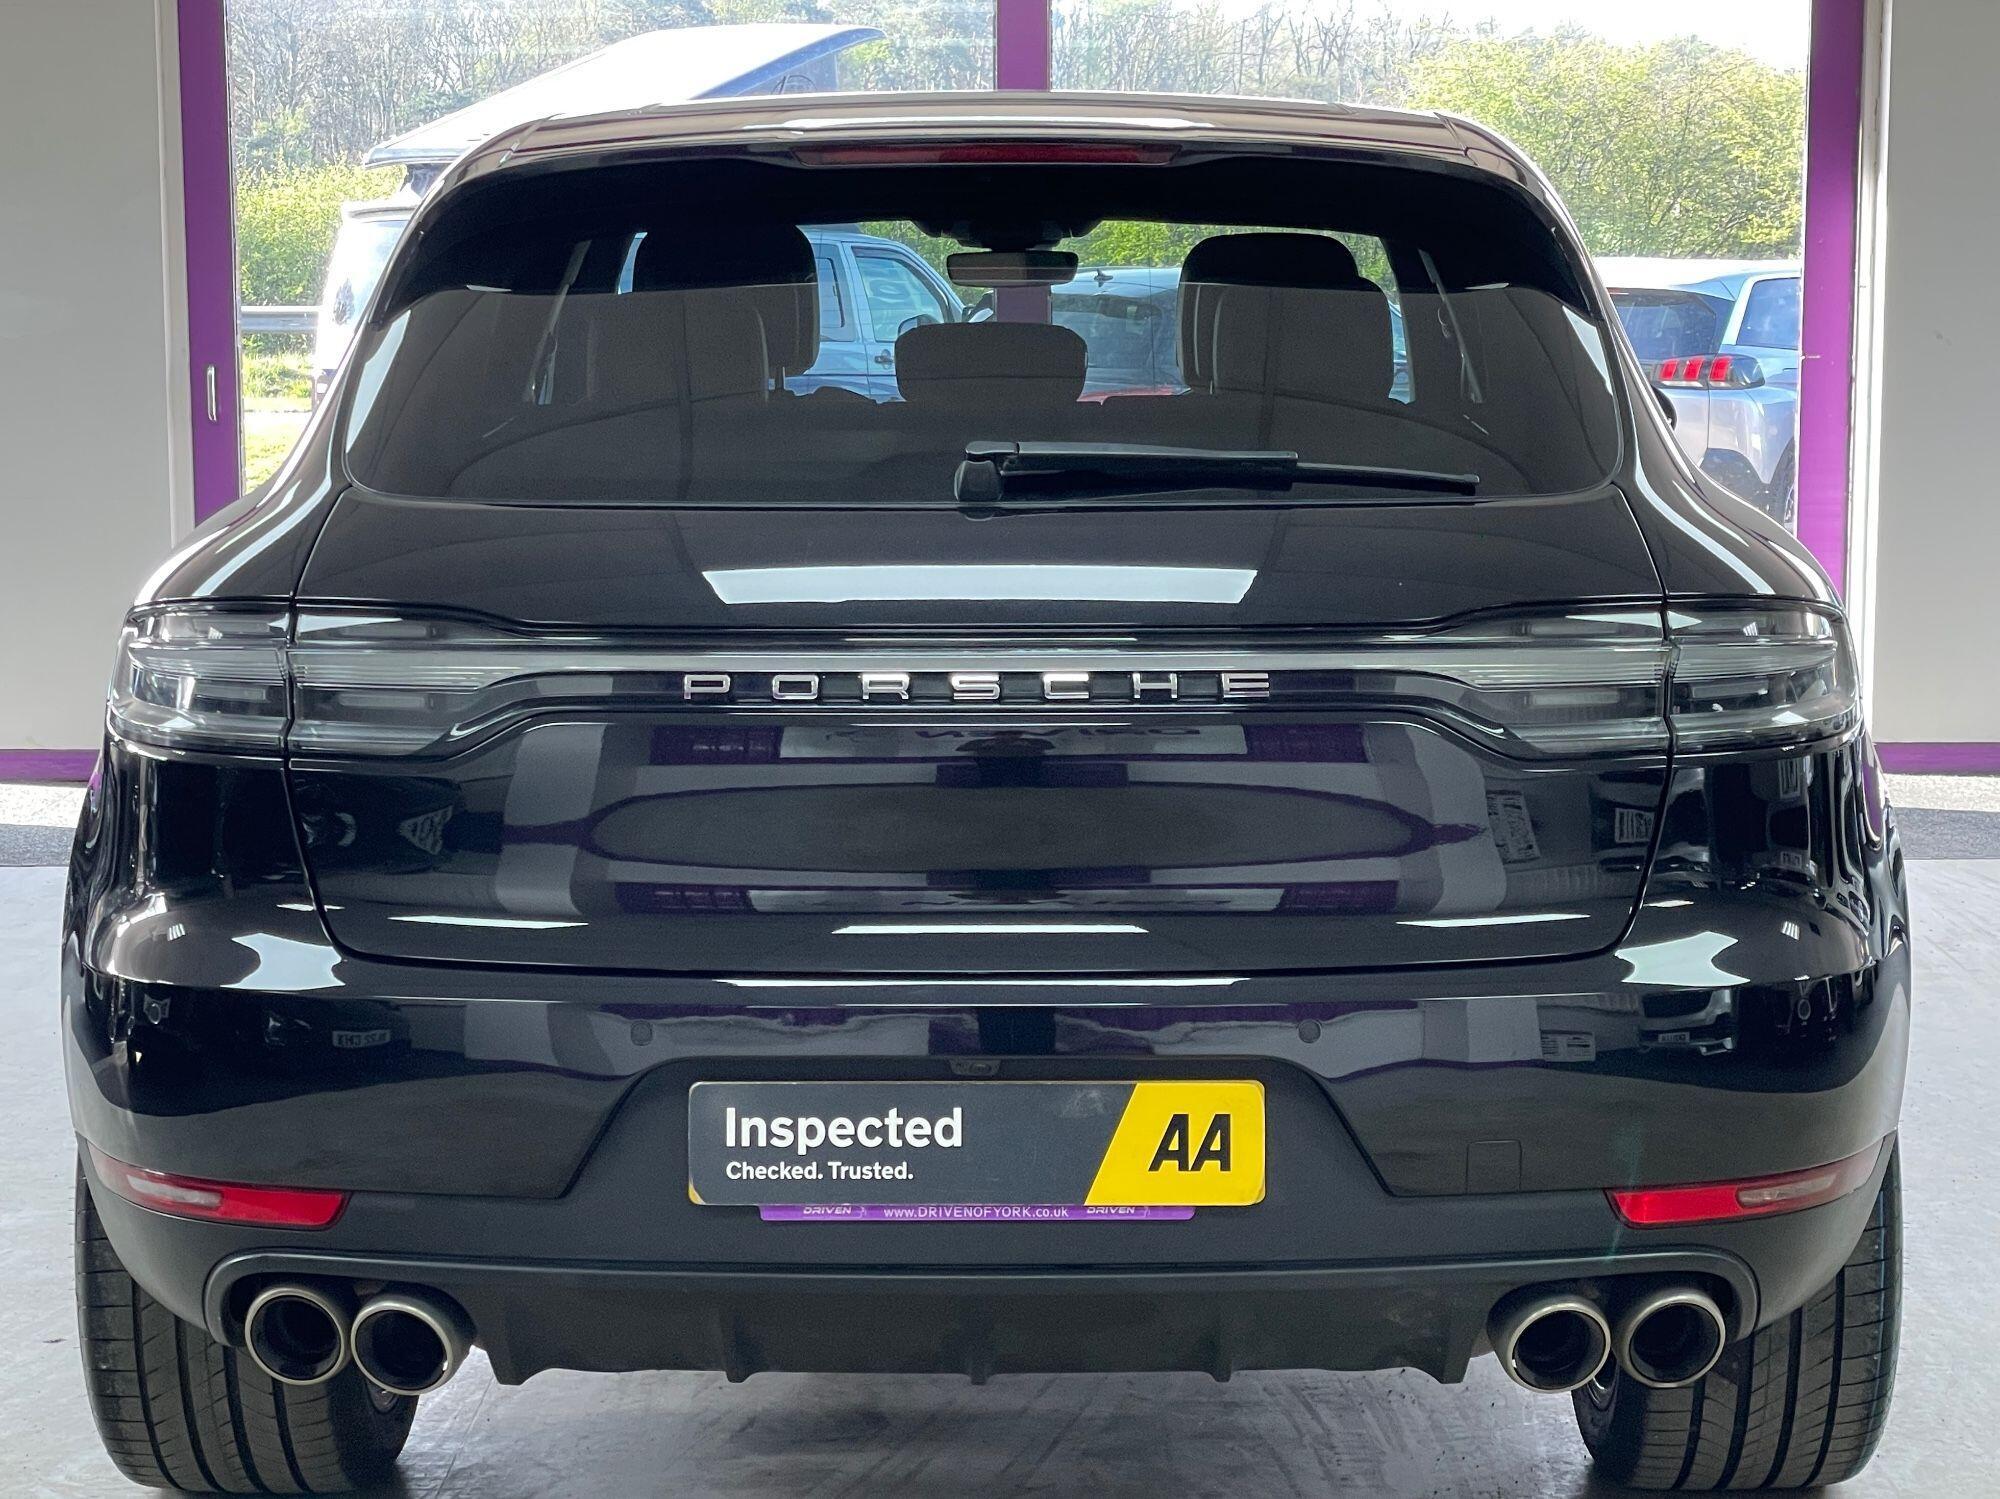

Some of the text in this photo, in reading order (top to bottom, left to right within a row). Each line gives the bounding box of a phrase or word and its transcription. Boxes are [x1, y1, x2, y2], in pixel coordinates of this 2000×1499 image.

[683, 672, 1270, 700] PORSCHE
[725, 1106, 963, 1155] Inspected
[1148, 1113, 1232, 1172] AA
[725, 1160, 915, 1181] Checked. Trusted.
[803, 1206, 852, 1215] DRIVEN
[883, 1206, 1069, 1218] www.DRIVENOFYORK.co.uk
[1086, 1206, 1136, 1215] DRIVEN
